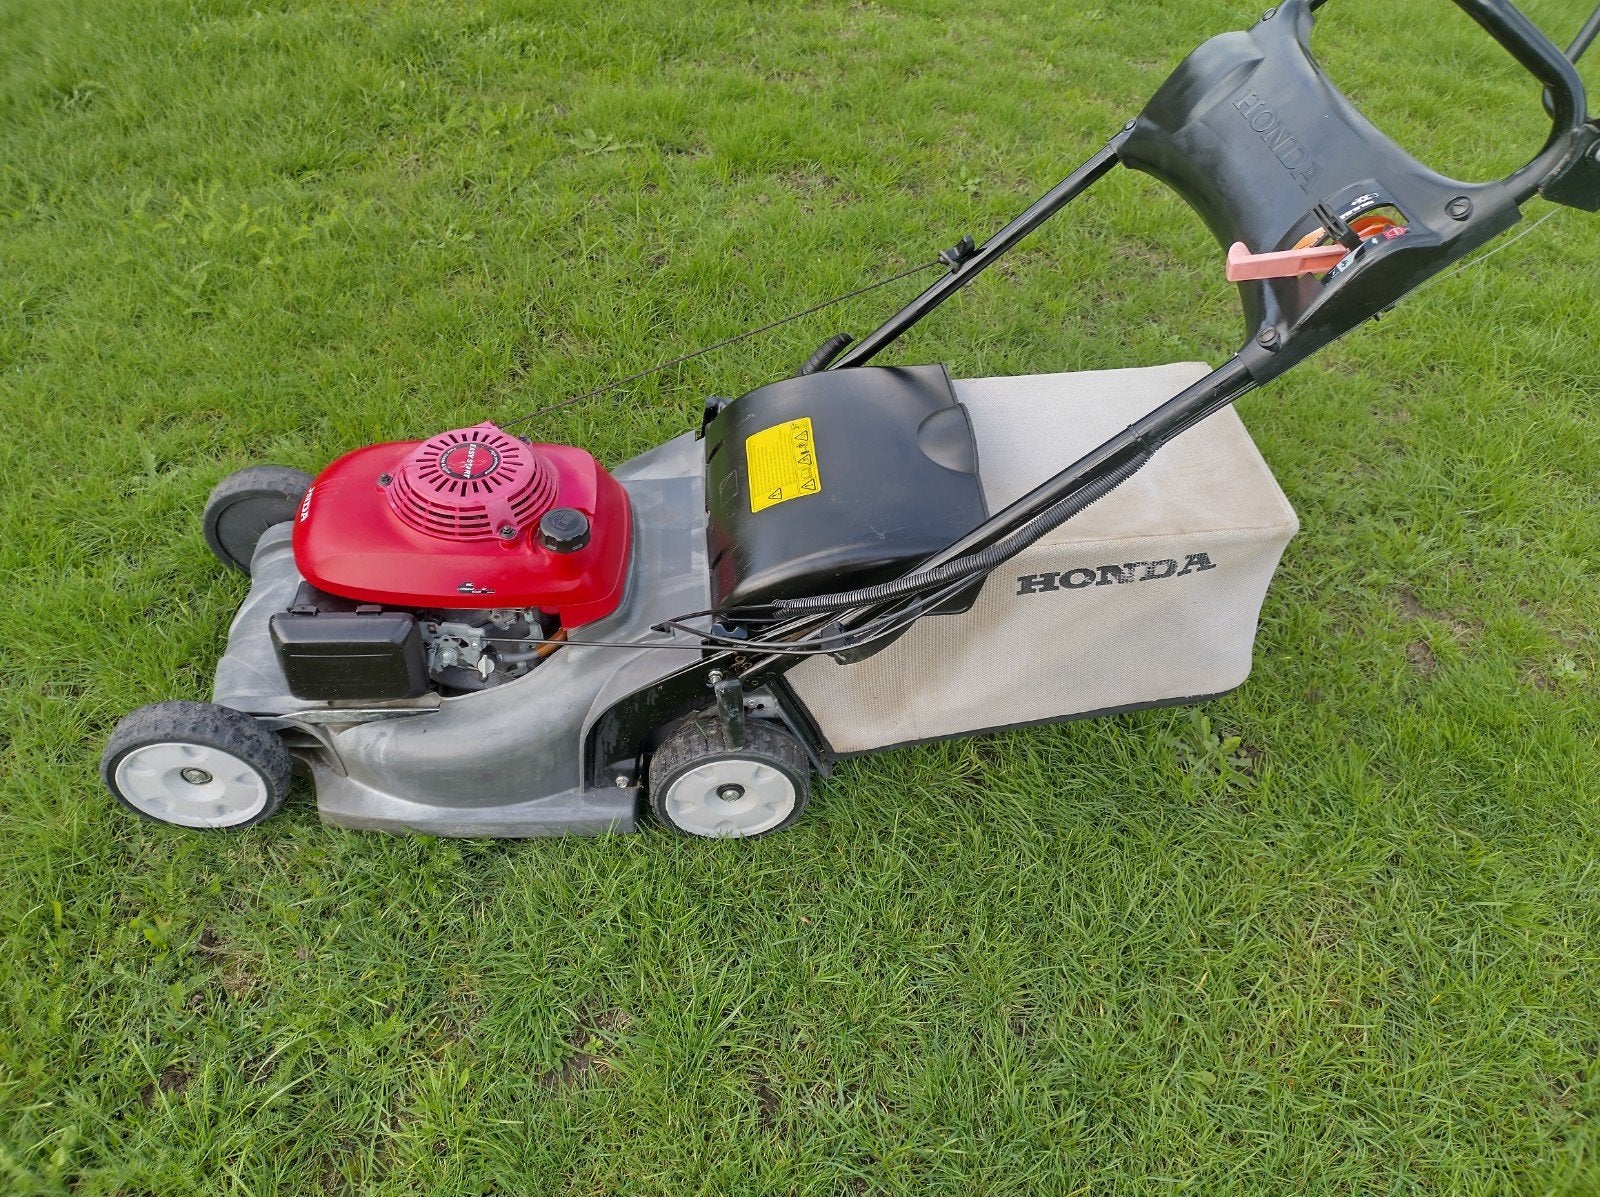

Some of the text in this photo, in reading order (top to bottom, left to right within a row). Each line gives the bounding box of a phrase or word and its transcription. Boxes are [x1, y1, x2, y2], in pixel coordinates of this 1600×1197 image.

[1232, 89, 1323, 195] HONDA
[463, 443, 477, 479] EASY START
[300, 486, 315, 523] NDA
[1016, 552, 1217, 596] HONDA
